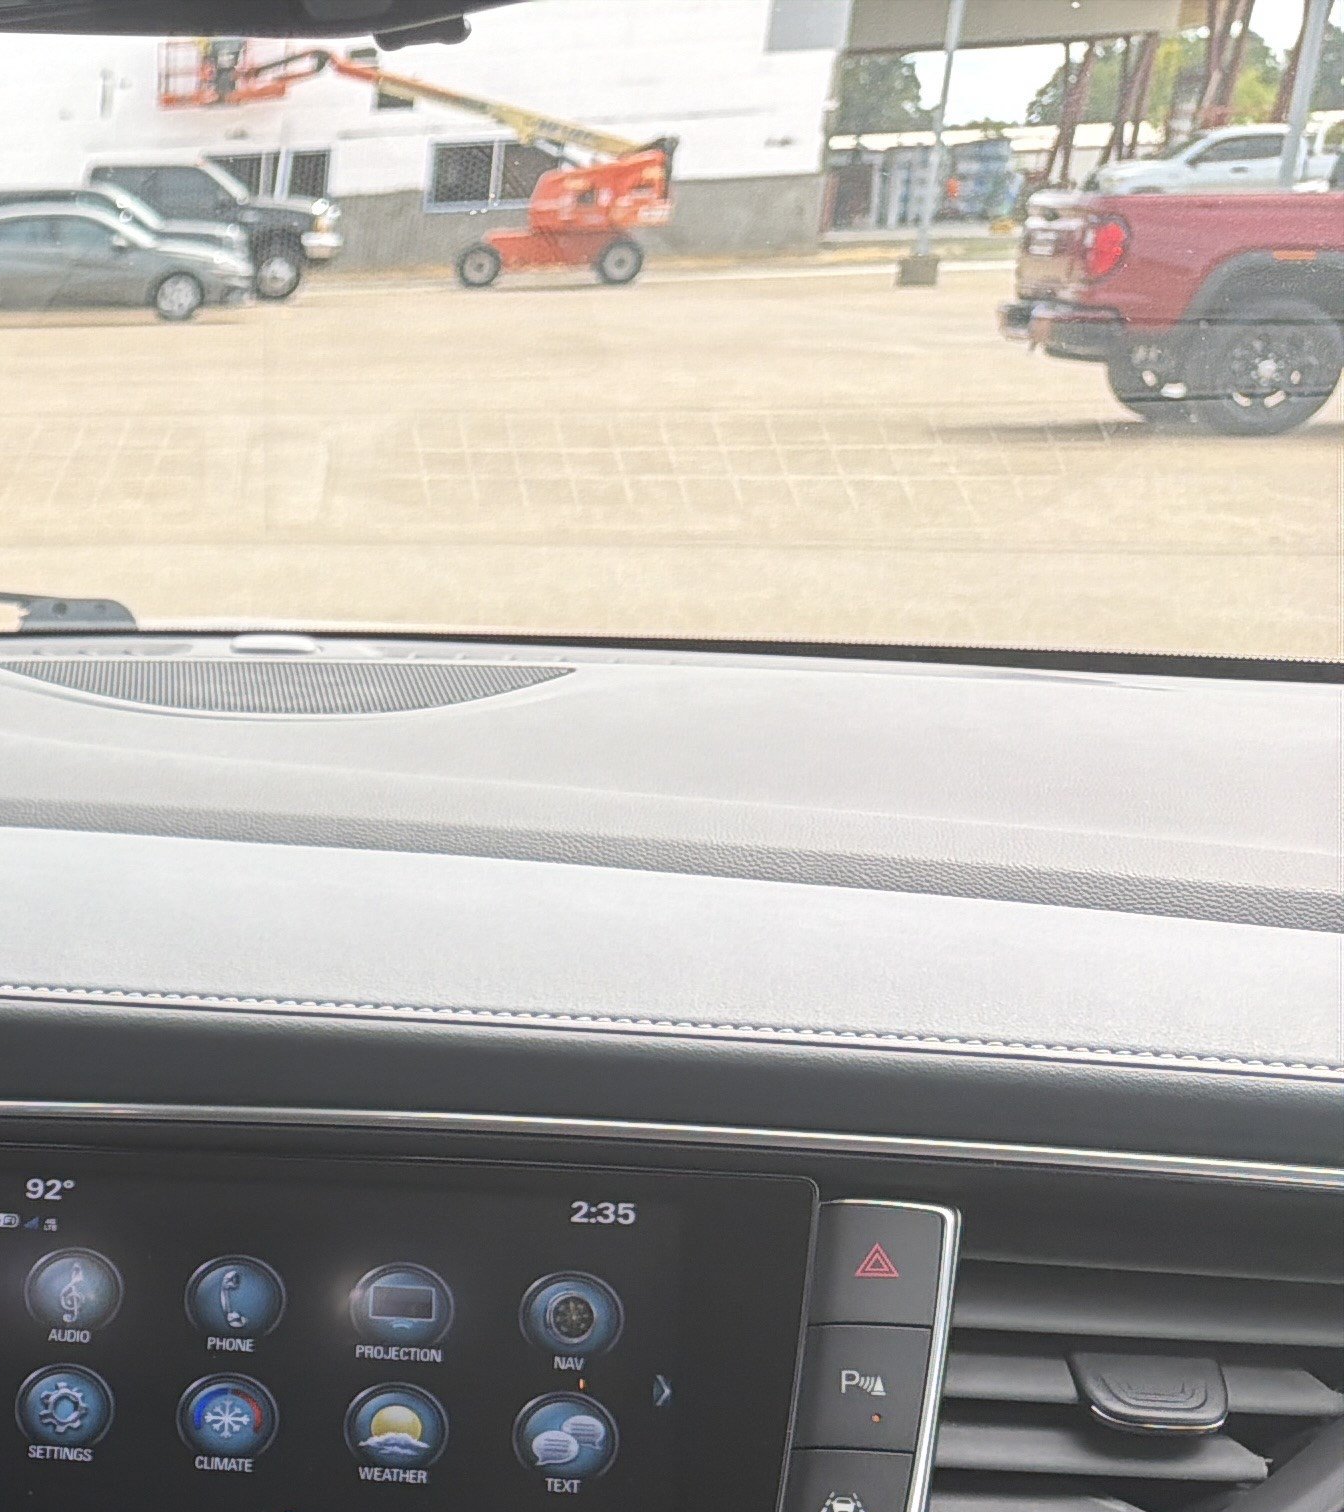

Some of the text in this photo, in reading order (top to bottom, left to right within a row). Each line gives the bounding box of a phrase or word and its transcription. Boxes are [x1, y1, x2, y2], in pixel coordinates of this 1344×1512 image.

[570, 1201, 636, 1225] 2:35
[47, 1328, 91, 1344] AUDIO
[206, 1336, 255, 1353] PHONE
[355, 1344, 443, 1363] PROJECTION
[553, 1355, 585, 1371] NAV
[27, 1445, 94, 1463] SETTINGS
[194, 1454, 254, 1473] CLIMATE
[358, 1466, 429, 1485] WEATHER
[545, 1477, 582, 1495] TEXT
